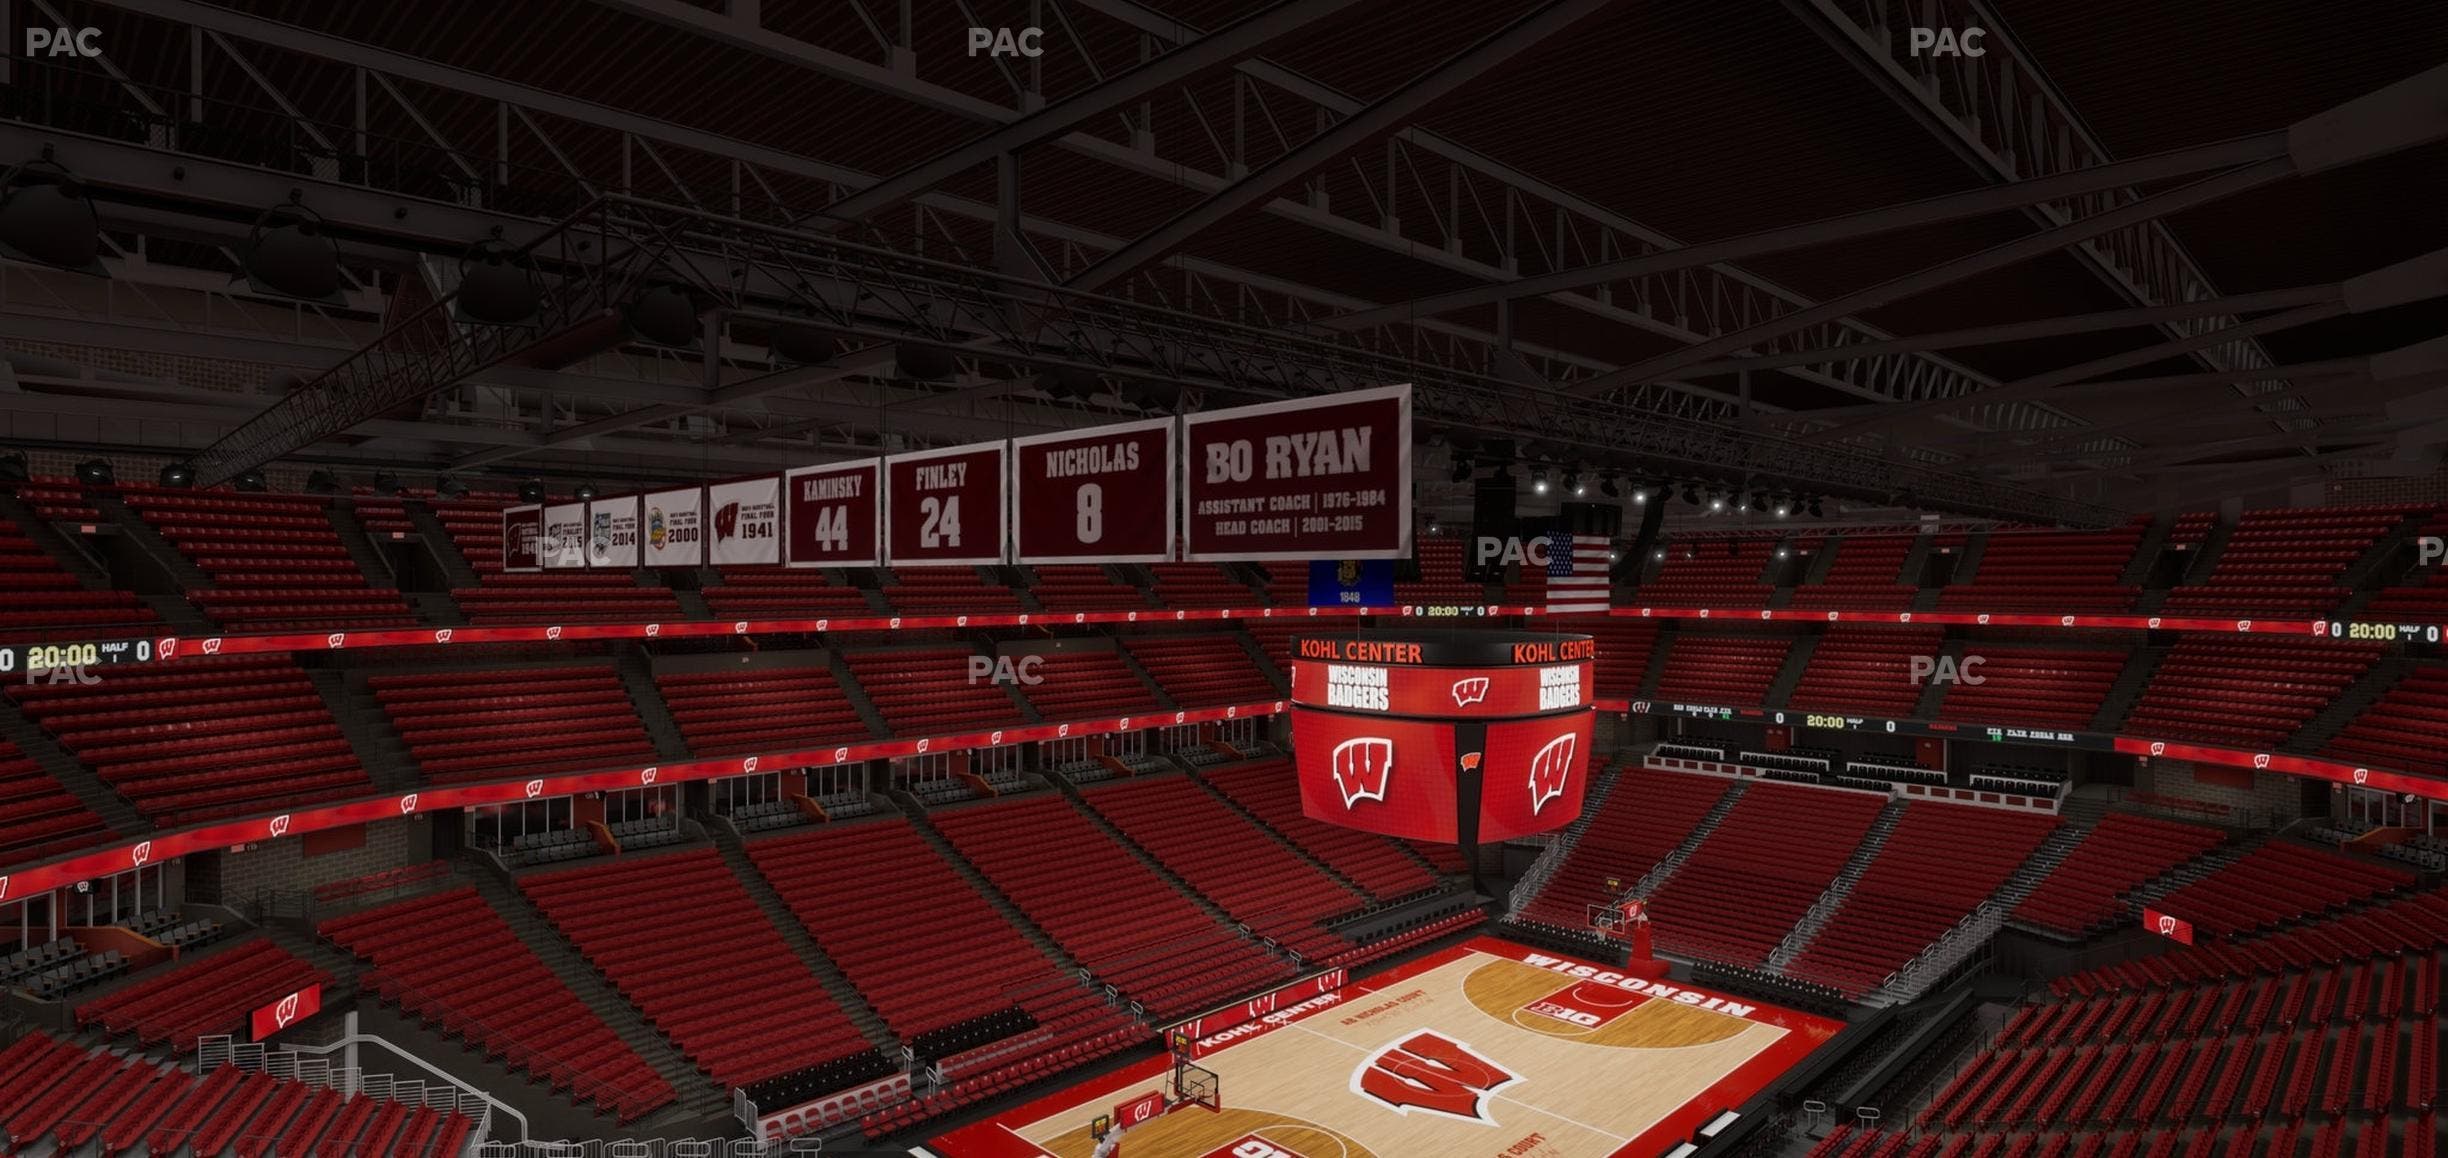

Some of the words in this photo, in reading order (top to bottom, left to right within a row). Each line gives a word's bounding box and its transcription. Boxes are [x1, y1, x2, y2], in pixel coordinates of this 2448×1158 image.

[1046, 441, 1139, 478] NICHOLAS
[1206, 439, 1253, 484] BO
[1265, 425, 1372, 480] RYAN
[804, 475, 863, 502] KAMINSKY
[916, 462, 967, 491] FINLEY
[1077, 483, 1102, 544] 8
[1198, 497, 1265, 515] ASSISTANT
[1270, 494, 1311, 511] COACH
[1323, 489, 1386, 509] 1976-1984
[741, 512, 758, 520] FINAL
[759, 511, 774, 519] FOUR
[920, 495, 961, 548] 24
[1216, 520, 1246, 536] HEAD
[1250, 518, 1290, 535] COACH
[1302, 515, 1363, 533] 2001-2015
[612, 532, 636, 546] 2014
[668, 527, 698, 544] 2000
[742, 522, 773, 539] 1941
[815, 505, 848, 552] 44
[1340, 591, 1360, 603] 1848
[1428, 606, 1458, 616] 20:00
[2331, 622, 2342, 637] 0
[2349, 623, 2396, 640] 20:00
[2427, 626, 2438, 642] 0
[0, 648, 14, 671] 0
[28, 644, 96, 669] 20:00
[101, 642, 129, 653] HALF
[136, 640, 150, 661] 0
[1301, 640, 1340, 659] KOHL
[1346, 642, 1422, 663] CENTER
[1515, 643, 1556, 663] KOHL
[1560, 640, 1594, 660] CENTER
[1328, 664, 1388, 687] WISCONSIN
[1328, 683, 1389, 711] BADGERS
[1540, 683, 1580, 711] BADGERS
[1776, 712, 1784, 724] 0
[1807, 715, 1845, 729] 20:00
[1886, 721, 1895, 732] 0
[1520, 953, 1757, 1017] WISCONSIN
[1198, 1020, 1262, 1048] KOHL
[1262, 991, 1341, 1025] CENTER
[1507, 1132, 1546, 1155] COURT
